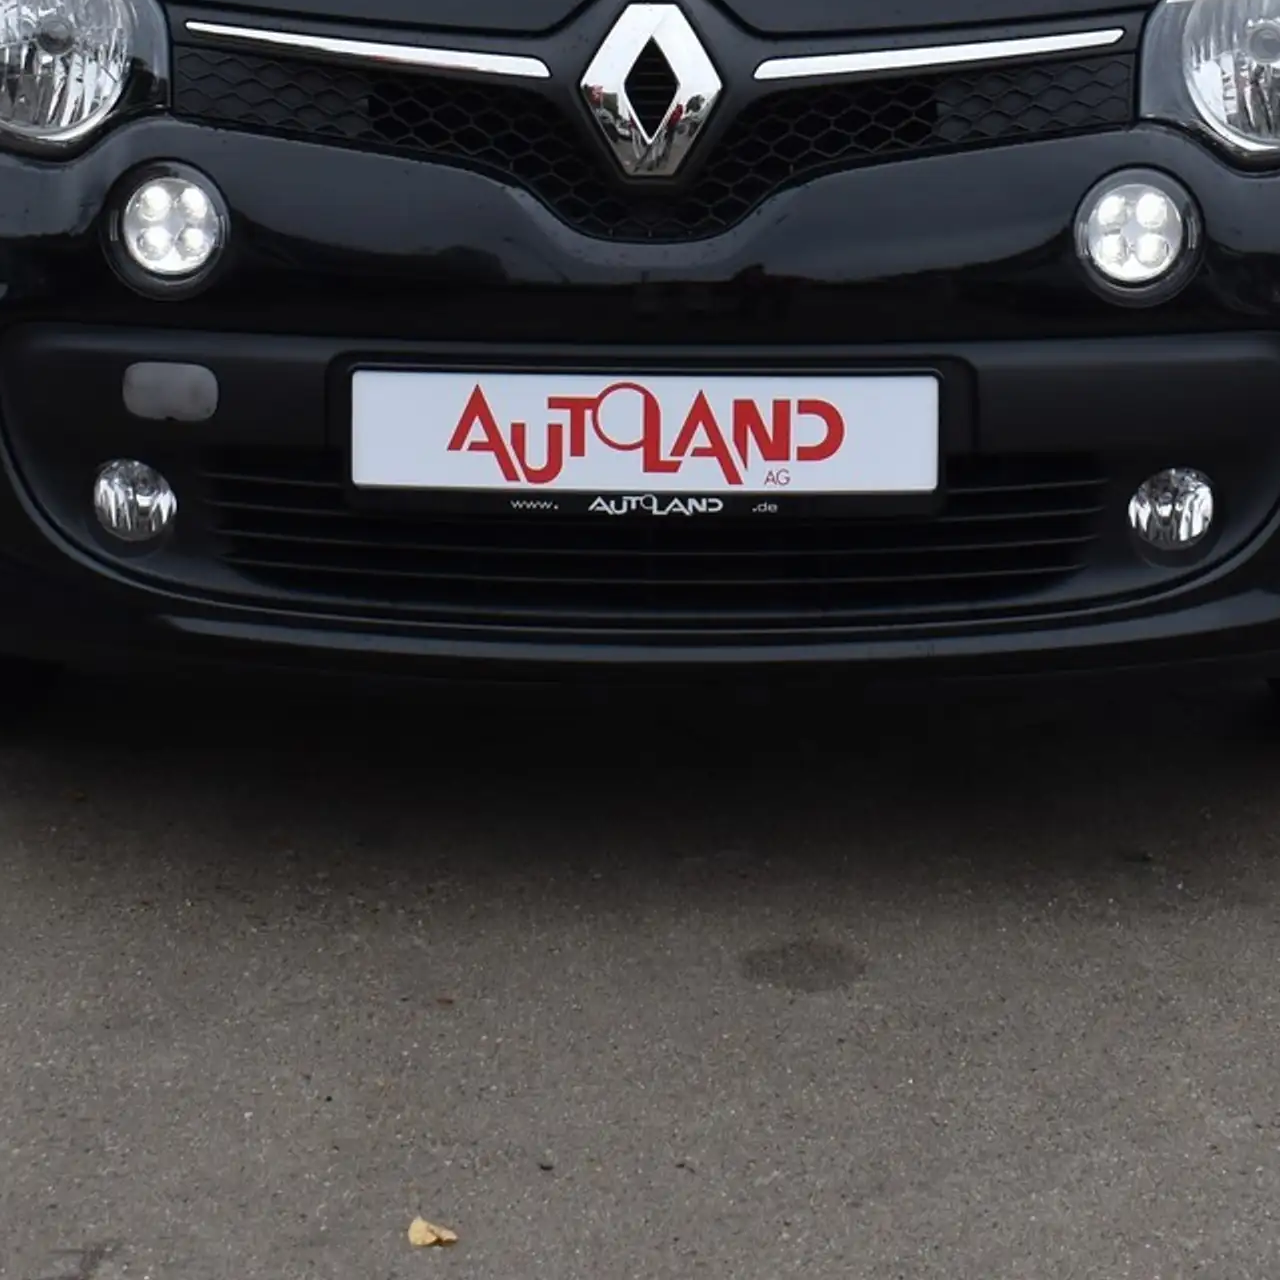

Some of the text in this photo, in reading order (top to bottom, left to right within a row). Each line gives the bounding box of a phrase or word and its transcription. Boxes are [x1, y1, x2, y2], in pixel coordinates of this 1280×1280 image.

[447, 382, 846, 486] AUTOLAND
[763, 468, 791, 487] AG
[510, 493, 779, 516] www. AUTOLAND .de
